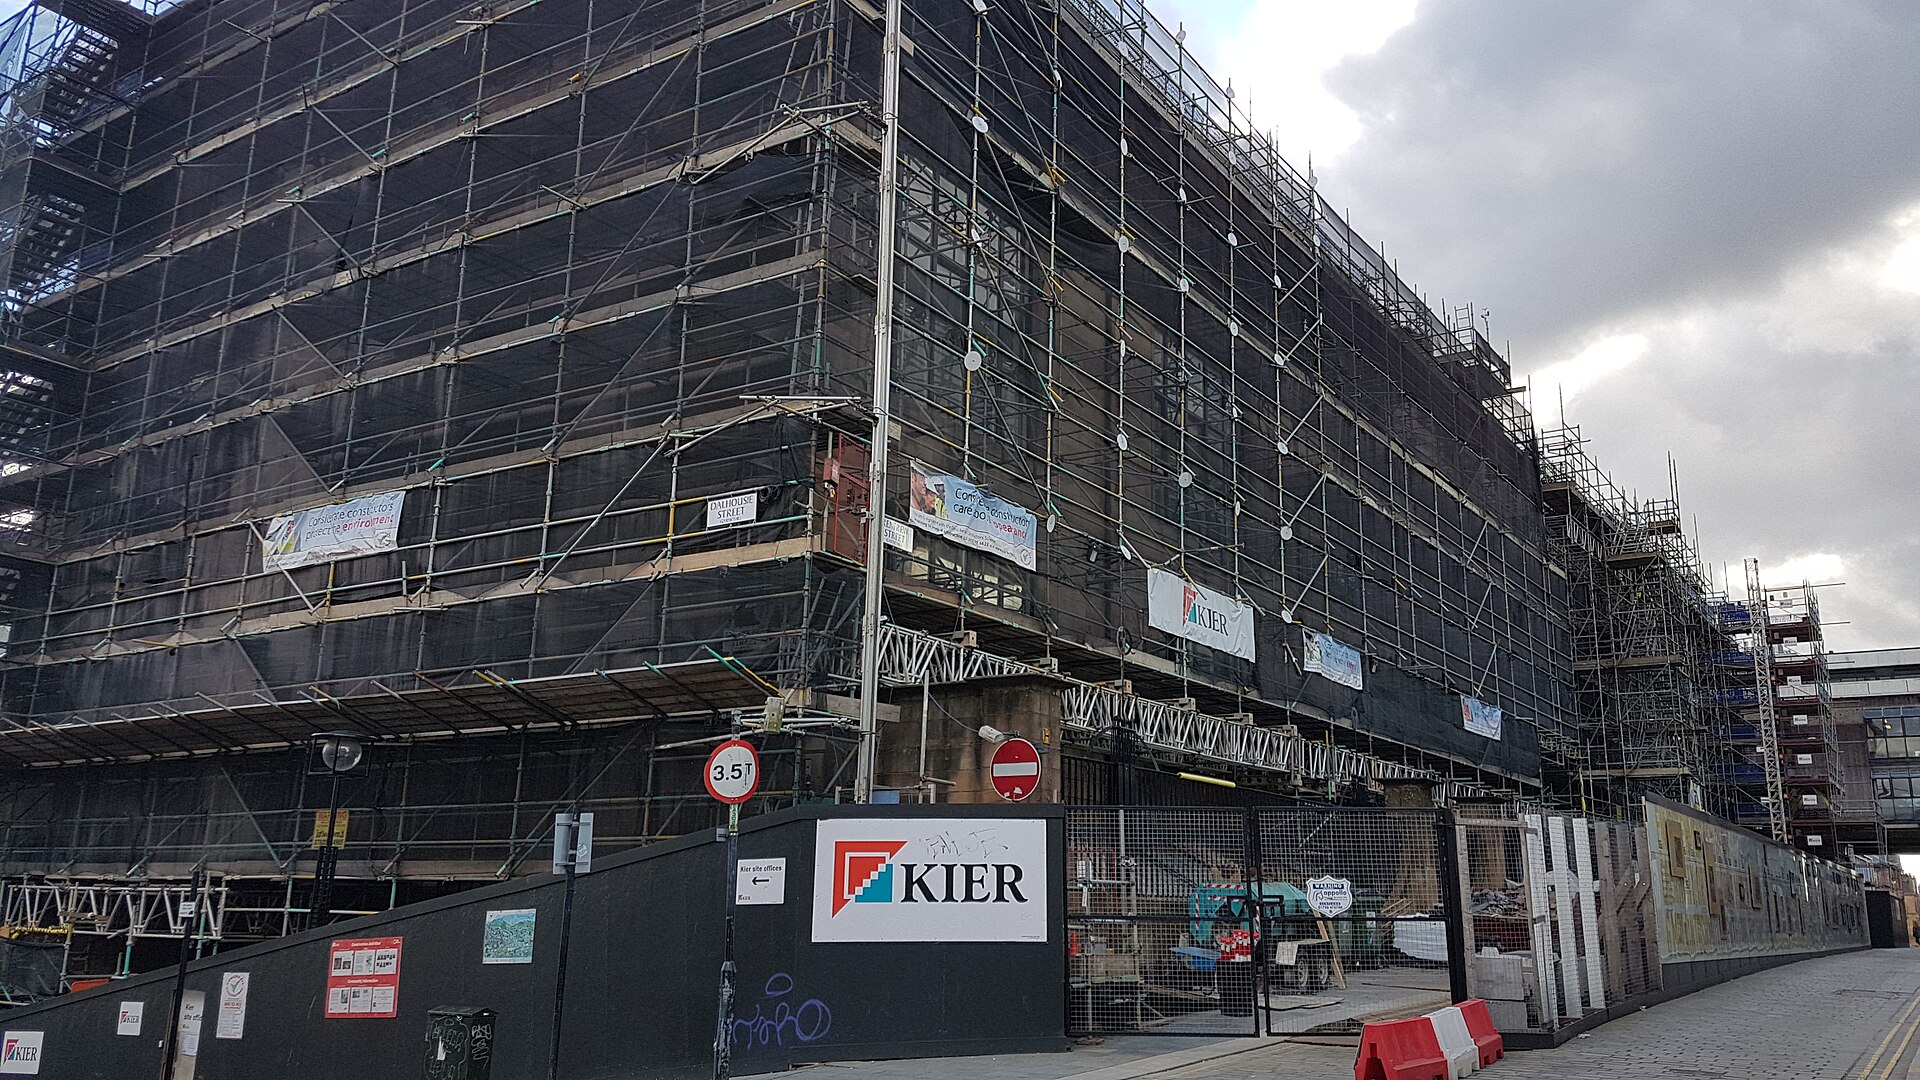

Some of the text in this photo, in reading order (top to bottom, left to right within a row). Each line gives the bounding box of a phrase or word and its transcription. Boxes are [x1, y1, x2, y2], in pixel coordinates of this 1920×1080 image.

[710, 495, 753, 511] DALHOUSIE
[953, 503, 973, 515] care
[717, 507, 744, 519] STREET
[1197, 604, 1229, 636] KIER
[900, 863, 1028, 903] KIER
[15, 1047, 38, 1061] KIER
